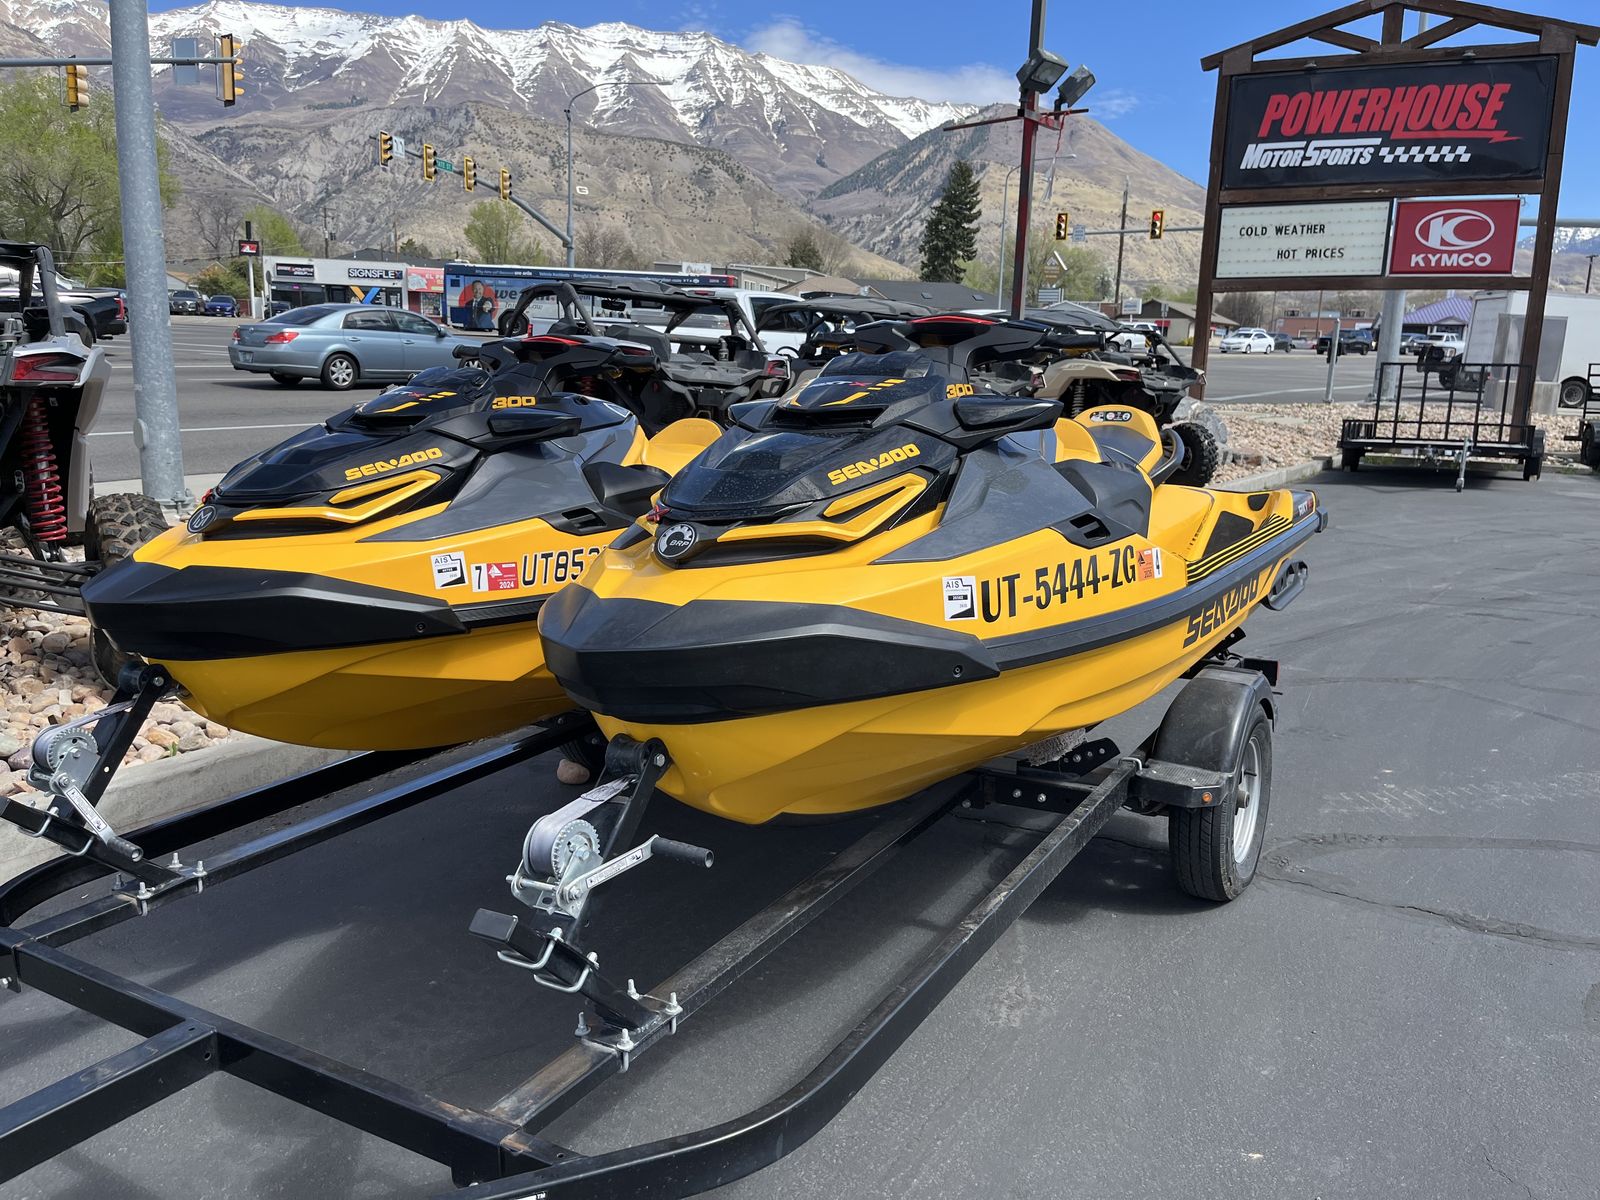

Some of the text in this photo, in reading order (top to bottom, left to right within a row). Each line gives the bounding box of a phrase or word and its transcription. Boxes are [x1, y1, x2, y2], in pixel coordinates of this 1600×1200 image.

[1257, 83, 1511, 139] POWERHOUSE
[1239, 224, 1326, 237] COLD WEATHER
[1276, 247, 1345, 260] HOT PRICES
[1410, 252, 1492, 267] KYMCO
[349, 268, 401, 279] SIGNSFLEX
[946, 384, 974, 399] 300
[492, 396, 536, 409] 300
[669, 539, 690, 547] BRP
[434, 556, 448, 564] AIS
[522, 546, 606, 586] UT85
[474, 565, 482, 590] 7
[499, 581, 515, 589] 2024
[945, 580, 960, 589] AIS
